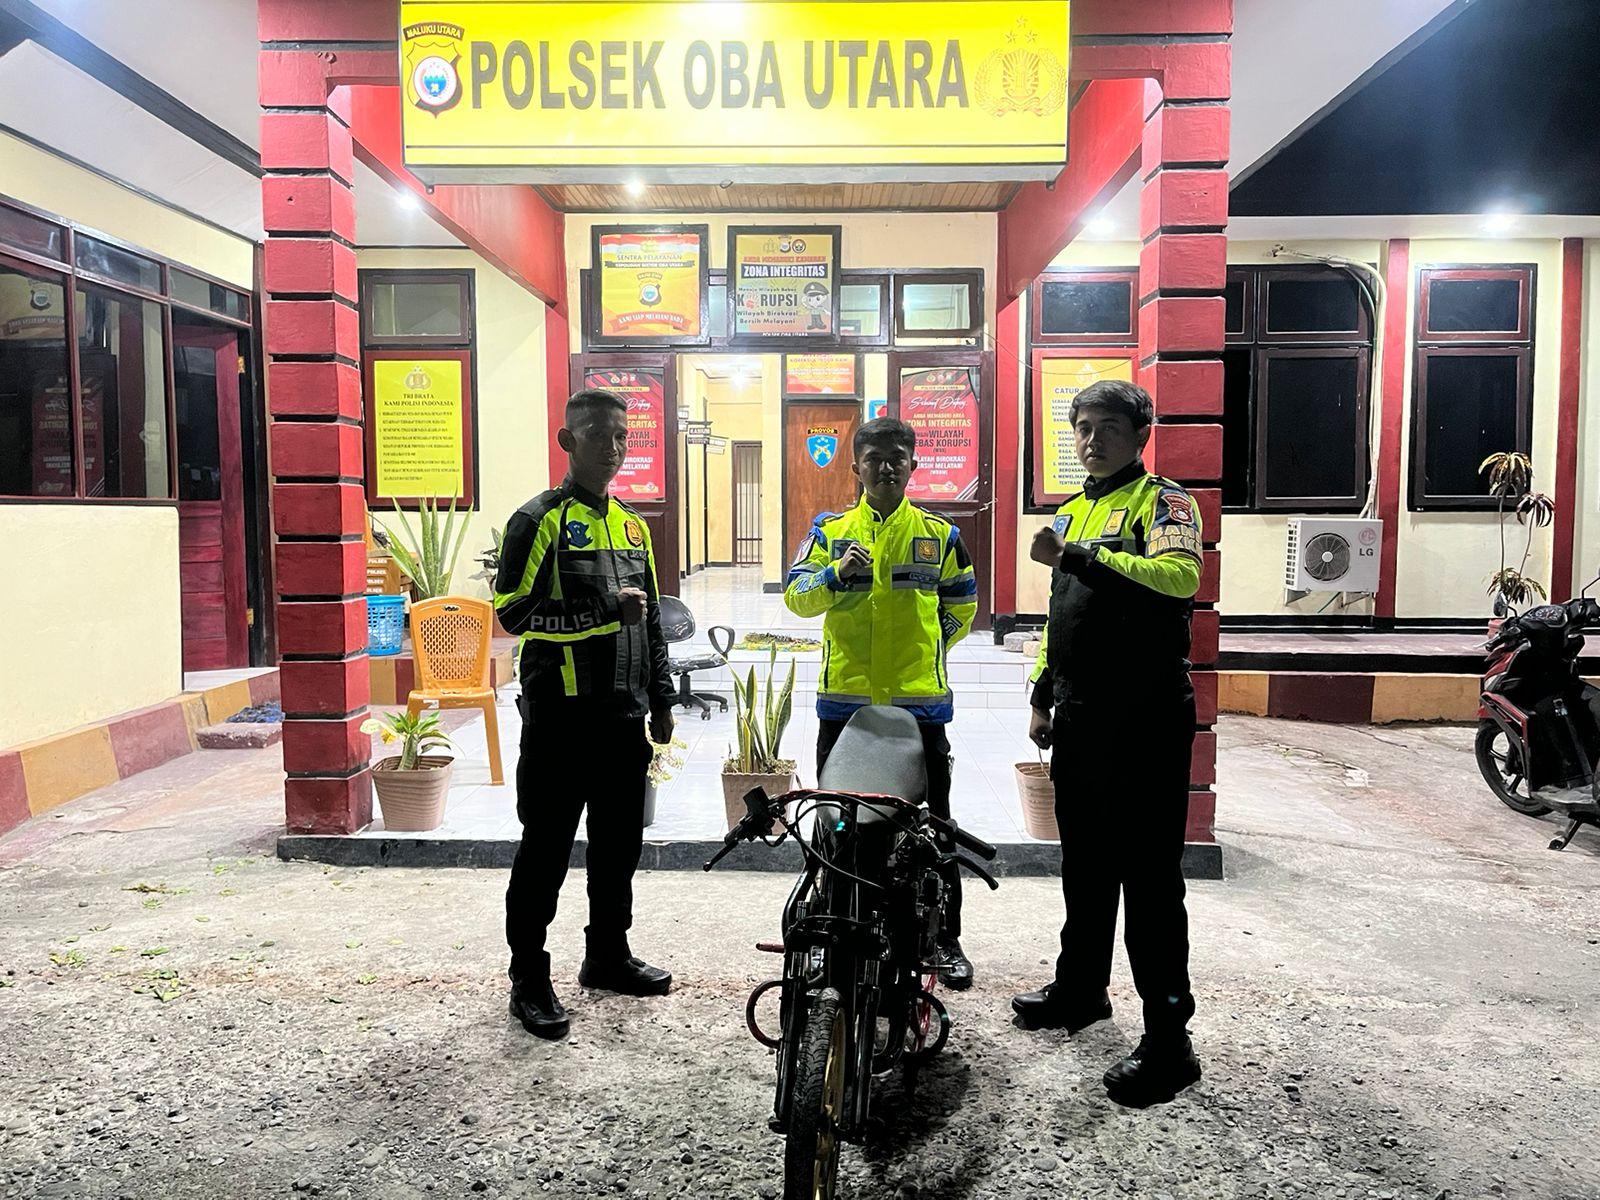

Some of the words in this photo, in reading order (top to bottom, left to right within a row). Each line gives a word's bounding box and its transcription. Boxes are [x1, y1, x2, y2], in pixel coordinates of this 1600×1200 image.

[406, 25, 436, 38] MALUKU
[437, 25, 461, 38] UTARA
[470, 40, 666, 109] POLSEK
[683, 40, 786, 109] OBA
[803, 39, 969, 109] UTARA
[743, 265, 769, 277] ZONA
[770, 265, 825, 277] INTEGRITAS
[737, 294, 798, 308] KRUPSI
[928, 419, 972, 427] INTEGRITAS
[929, 430, 964, 438] WILAYAH
[627, 440, 658, 448] ORUPSI
[914, 439, 934, 447] EBAS
[936, 439, 971, 447] KORUPSI
[1359, 548, 1374, 556] LG
[530, 609, 602, 631] POLISI
